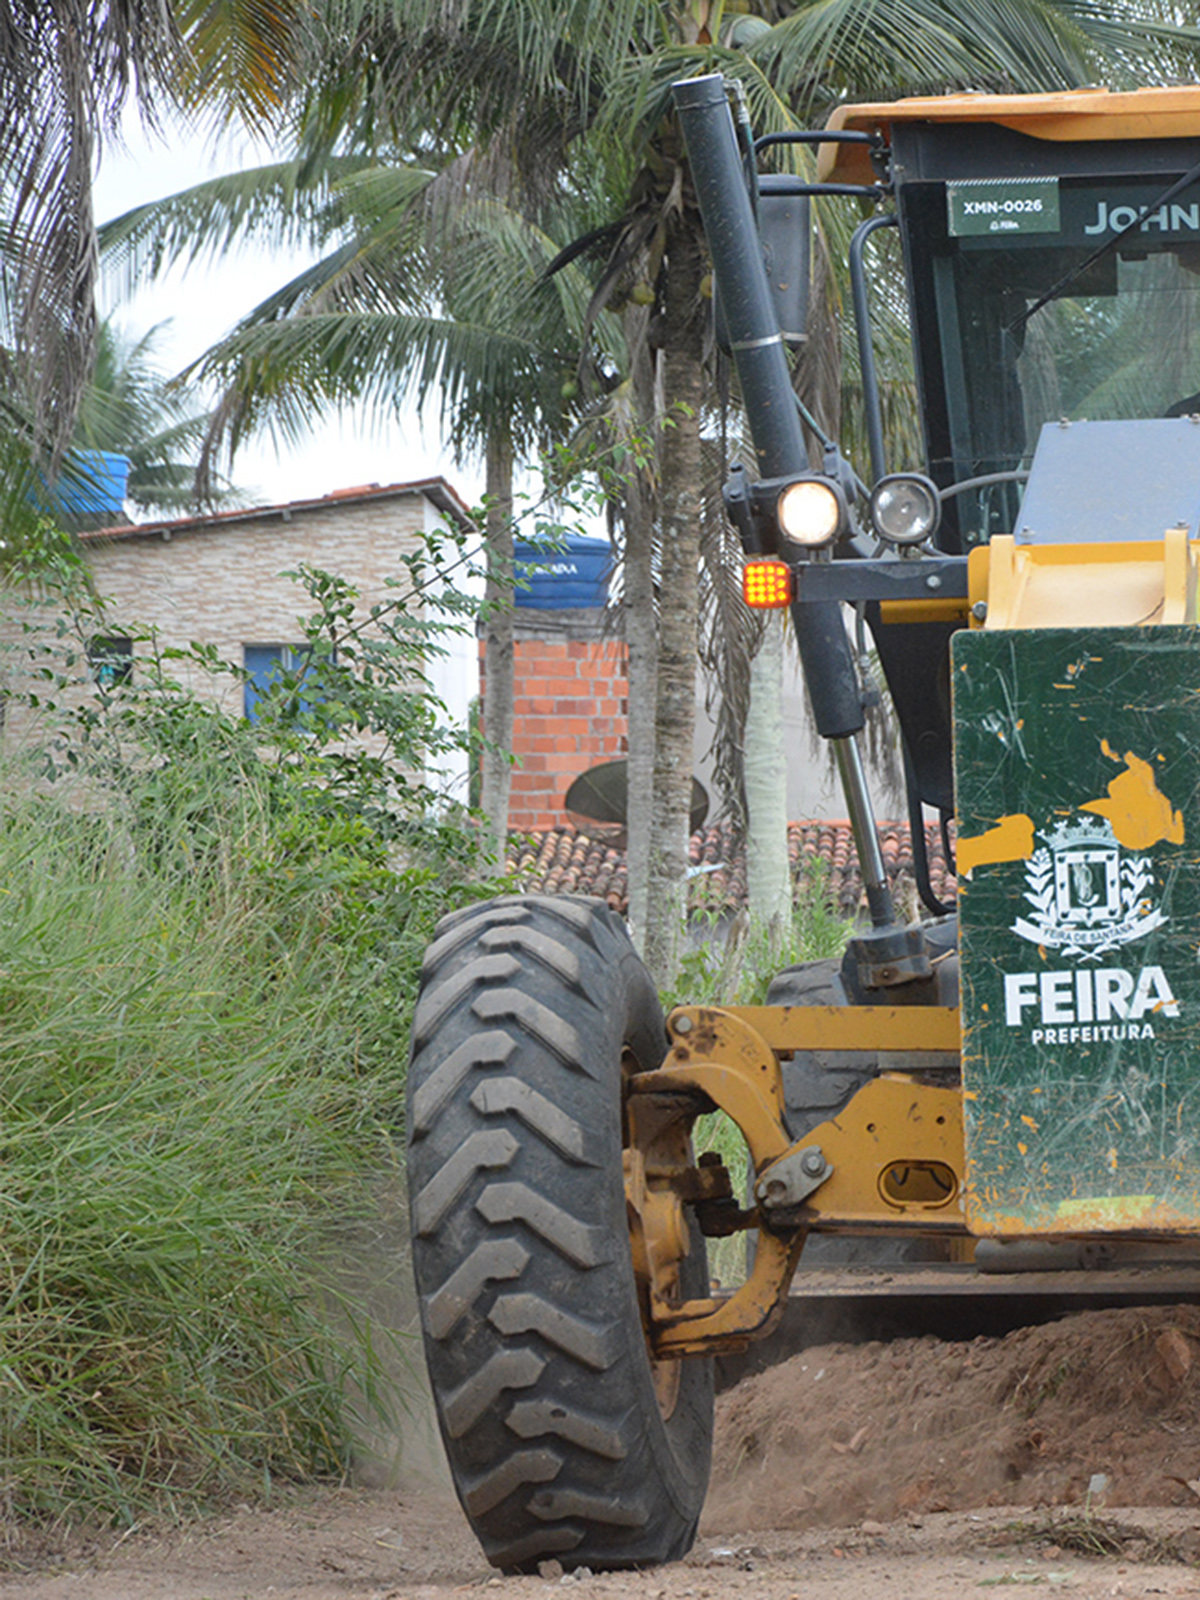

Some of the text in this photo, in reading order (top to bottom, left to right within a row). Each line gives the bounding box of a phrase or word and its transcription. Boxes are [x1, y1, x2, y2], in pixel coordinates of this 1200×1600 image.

[963, 199, 1043, 215] XMN-0026
[1084, 202, 1199, 235] JOHN
[1043, 923, 1135, 941] FEIRA DE SANTANA
[1004, 965, 1180, 1026] FEIRA
[1031, 1024, 1155, 1045] PREFEITURA
